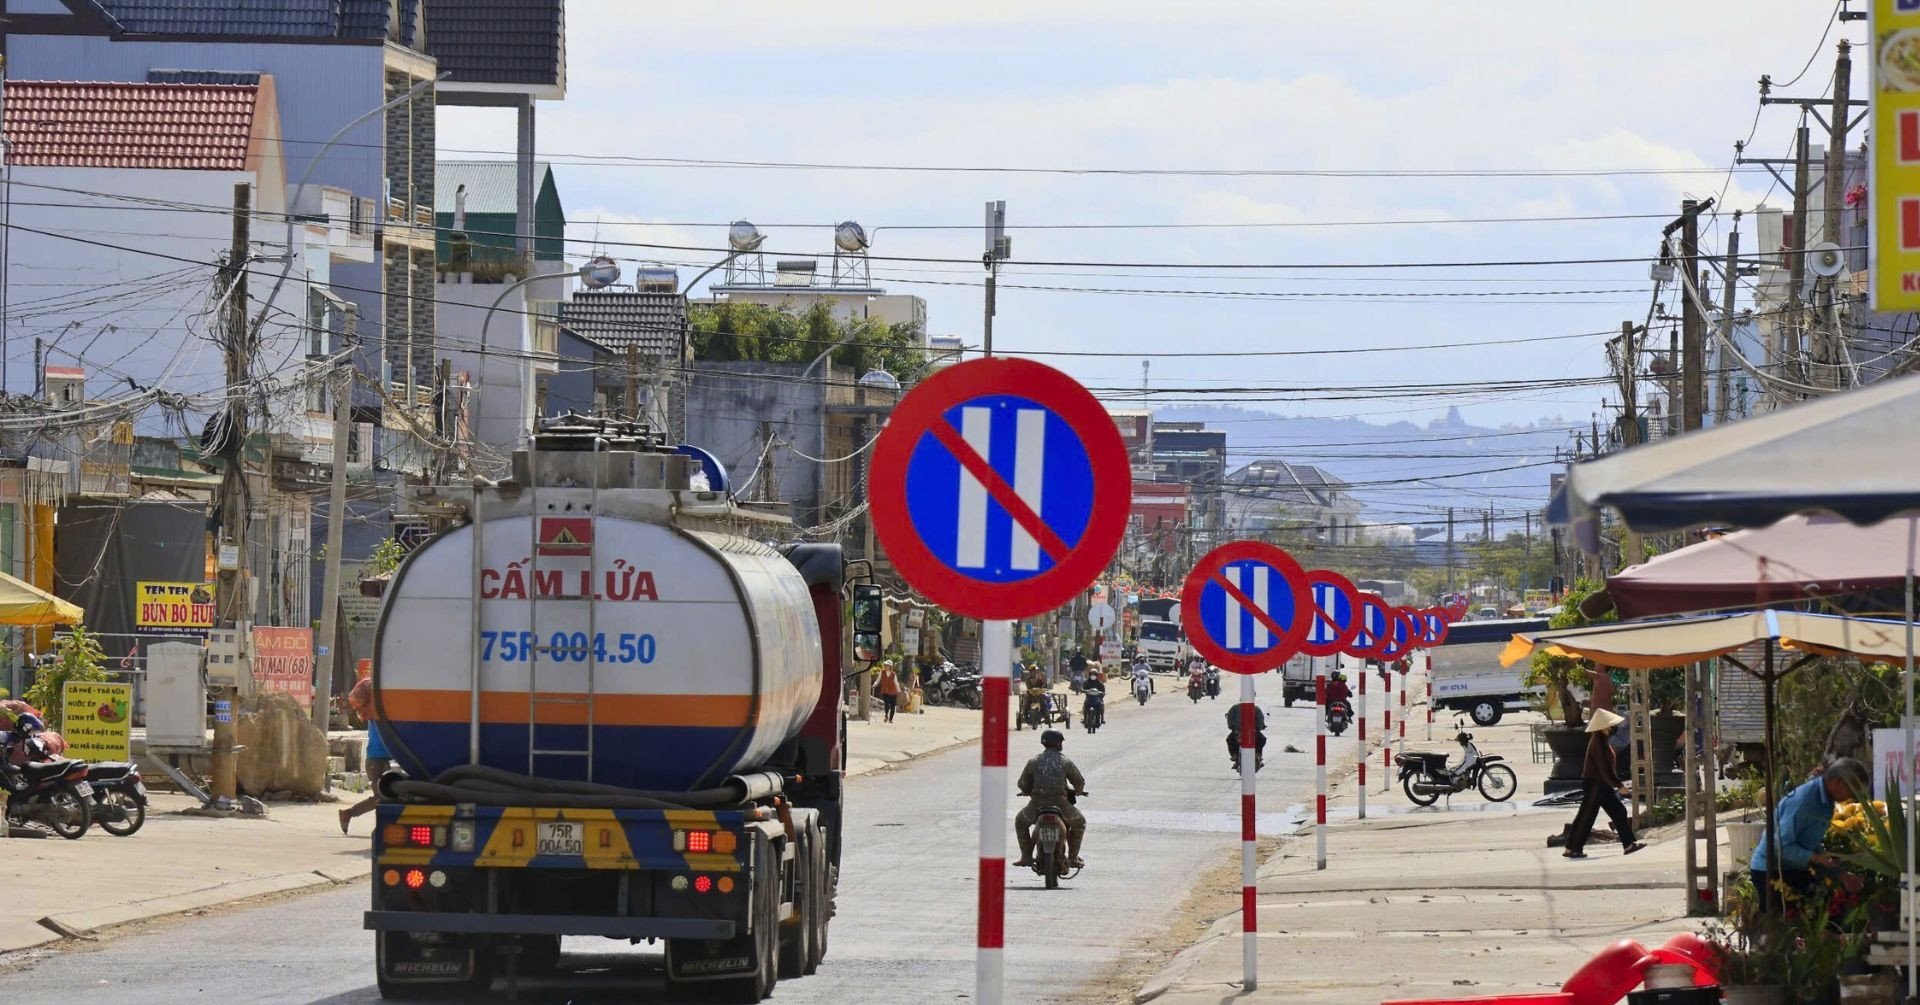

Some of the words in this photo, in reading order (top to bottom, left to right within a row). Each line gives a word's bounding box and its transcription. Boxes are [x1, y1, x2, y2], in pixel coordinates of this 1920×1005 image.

[144, 585, 166, 595] TEN
[168, 586, 189, 595] TEN
[480, 557, 563, 599] CẤM
[580, 558, 659, 601] LỬA
[142, 597, 168, 623] BÚN
[171, 598, 188, 623] BÒ
[480, 631, 657, 664] 75R-004.50
[288, 655, 310, 676] (68)
[549, 823, 573, 839] 75R
